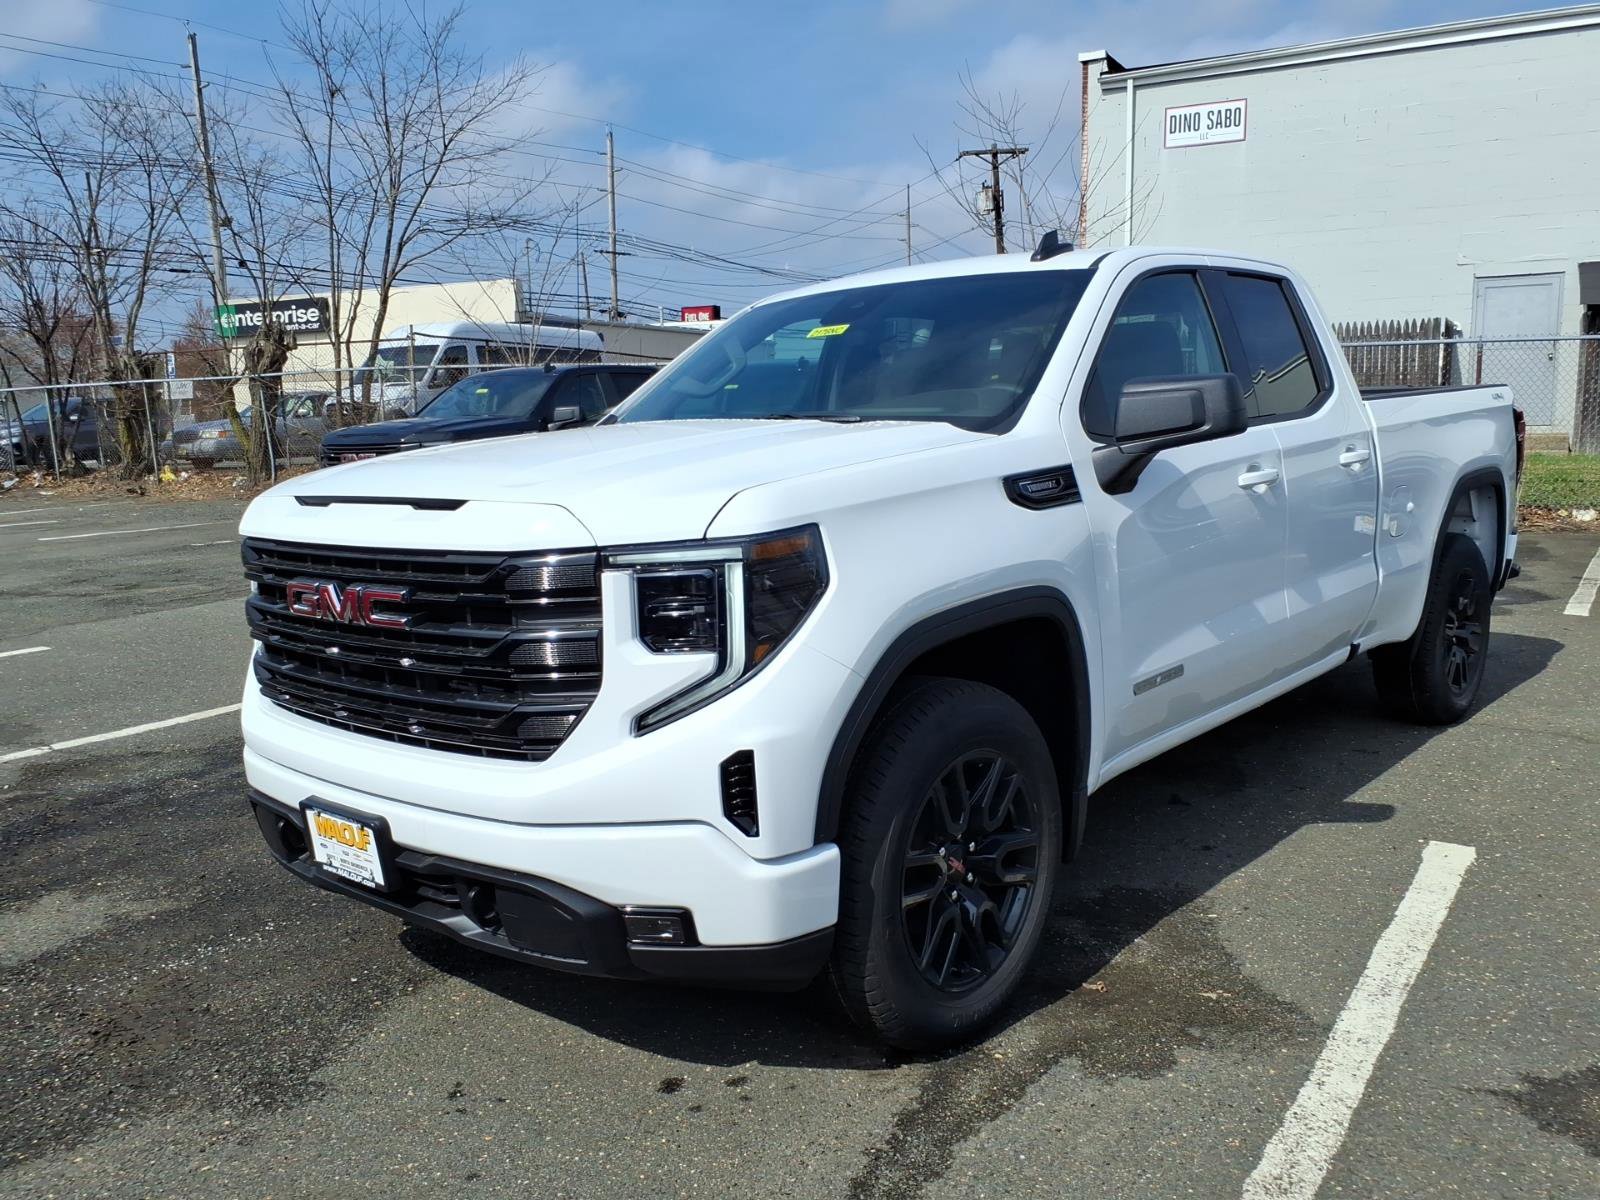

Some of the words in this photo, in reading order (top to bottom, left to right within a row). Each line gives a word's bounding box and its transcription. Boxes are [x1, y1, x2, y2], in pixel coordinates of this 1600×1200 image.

[1169, 112, 1201, 134] DINO
[1206, 107, 1242, 131] SABO
[286, 580, 410, 630] GMC
